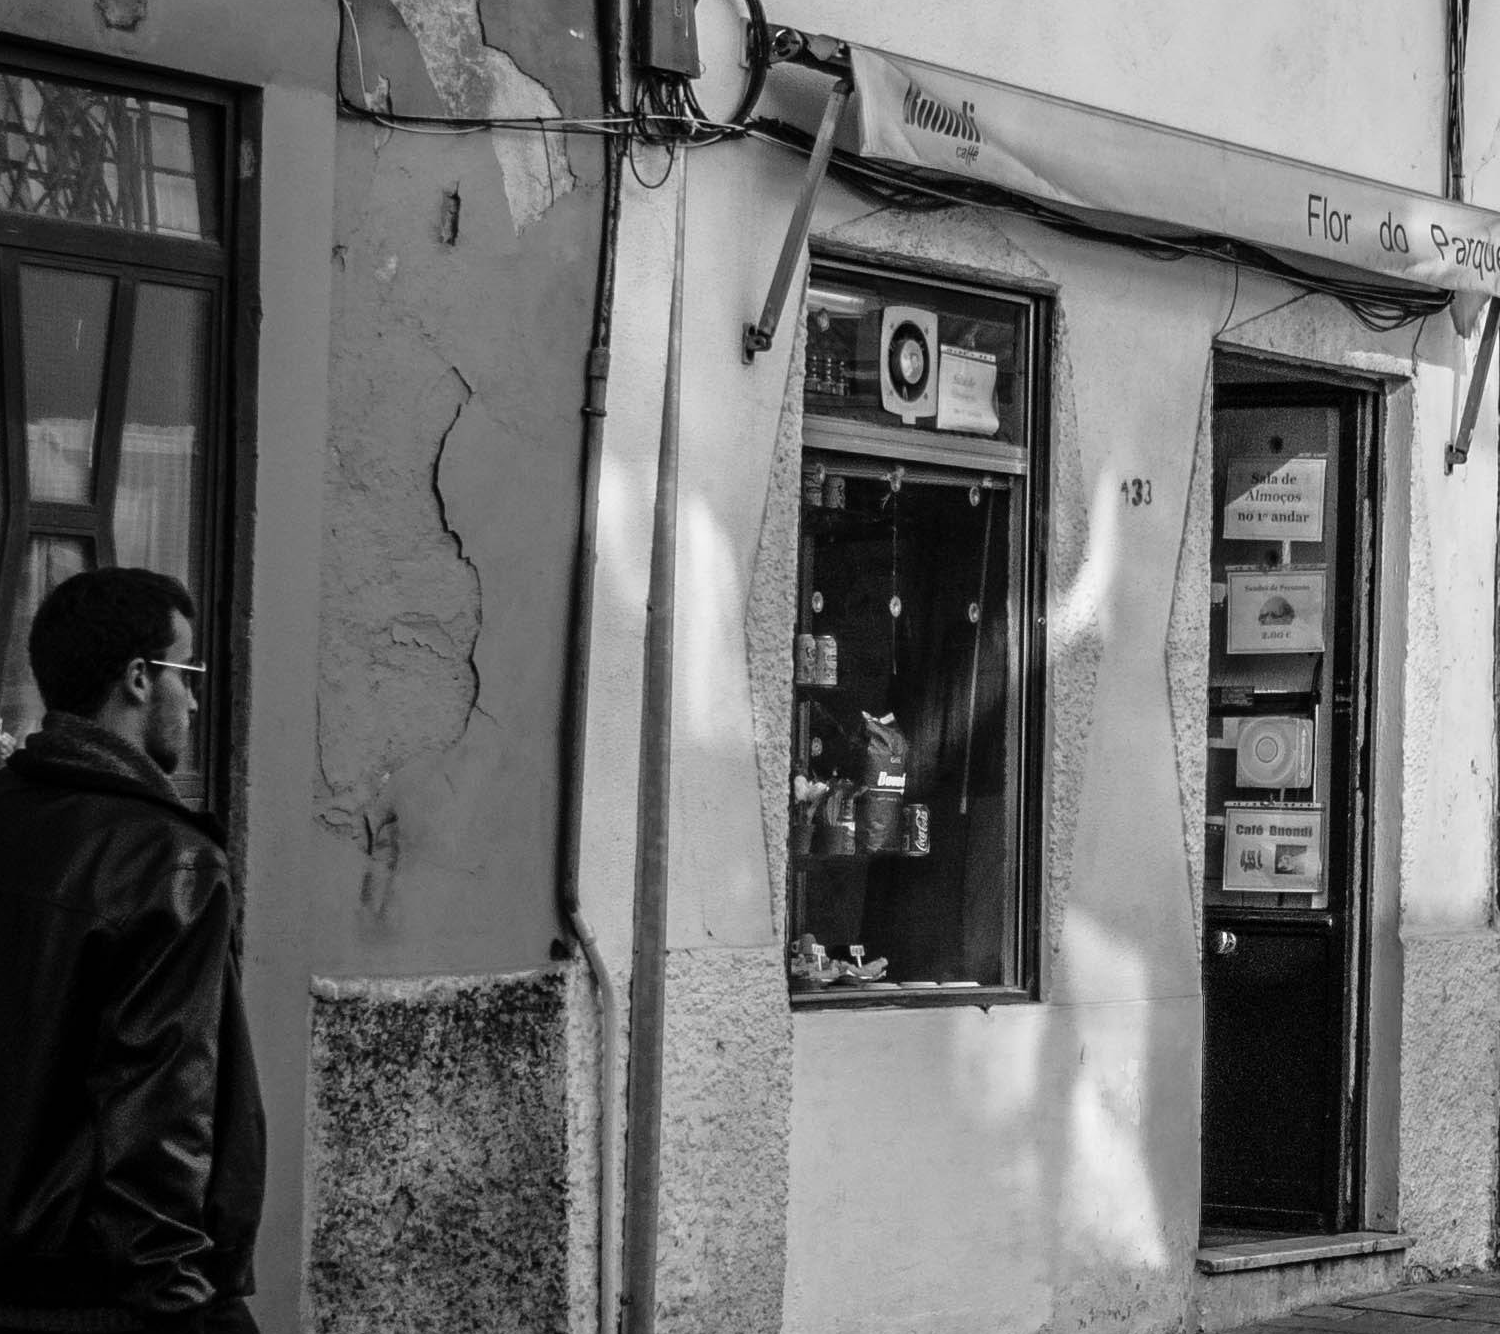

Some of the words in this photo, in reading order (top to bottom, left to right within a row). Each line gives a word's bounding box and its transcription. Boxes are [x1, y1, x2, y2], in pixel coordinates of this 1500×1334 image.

[1307, 193, 1351, 245] Flor
[1379, 211, 1410, 254] do
[1250, 472, 1278, 485] Sala
[1281, 472, 1297, 485] de
[1245, 490, 1301, 505] Almoços
[1237, 511, 1254, 522] no
[1271, 511, 1310, 523] andar
